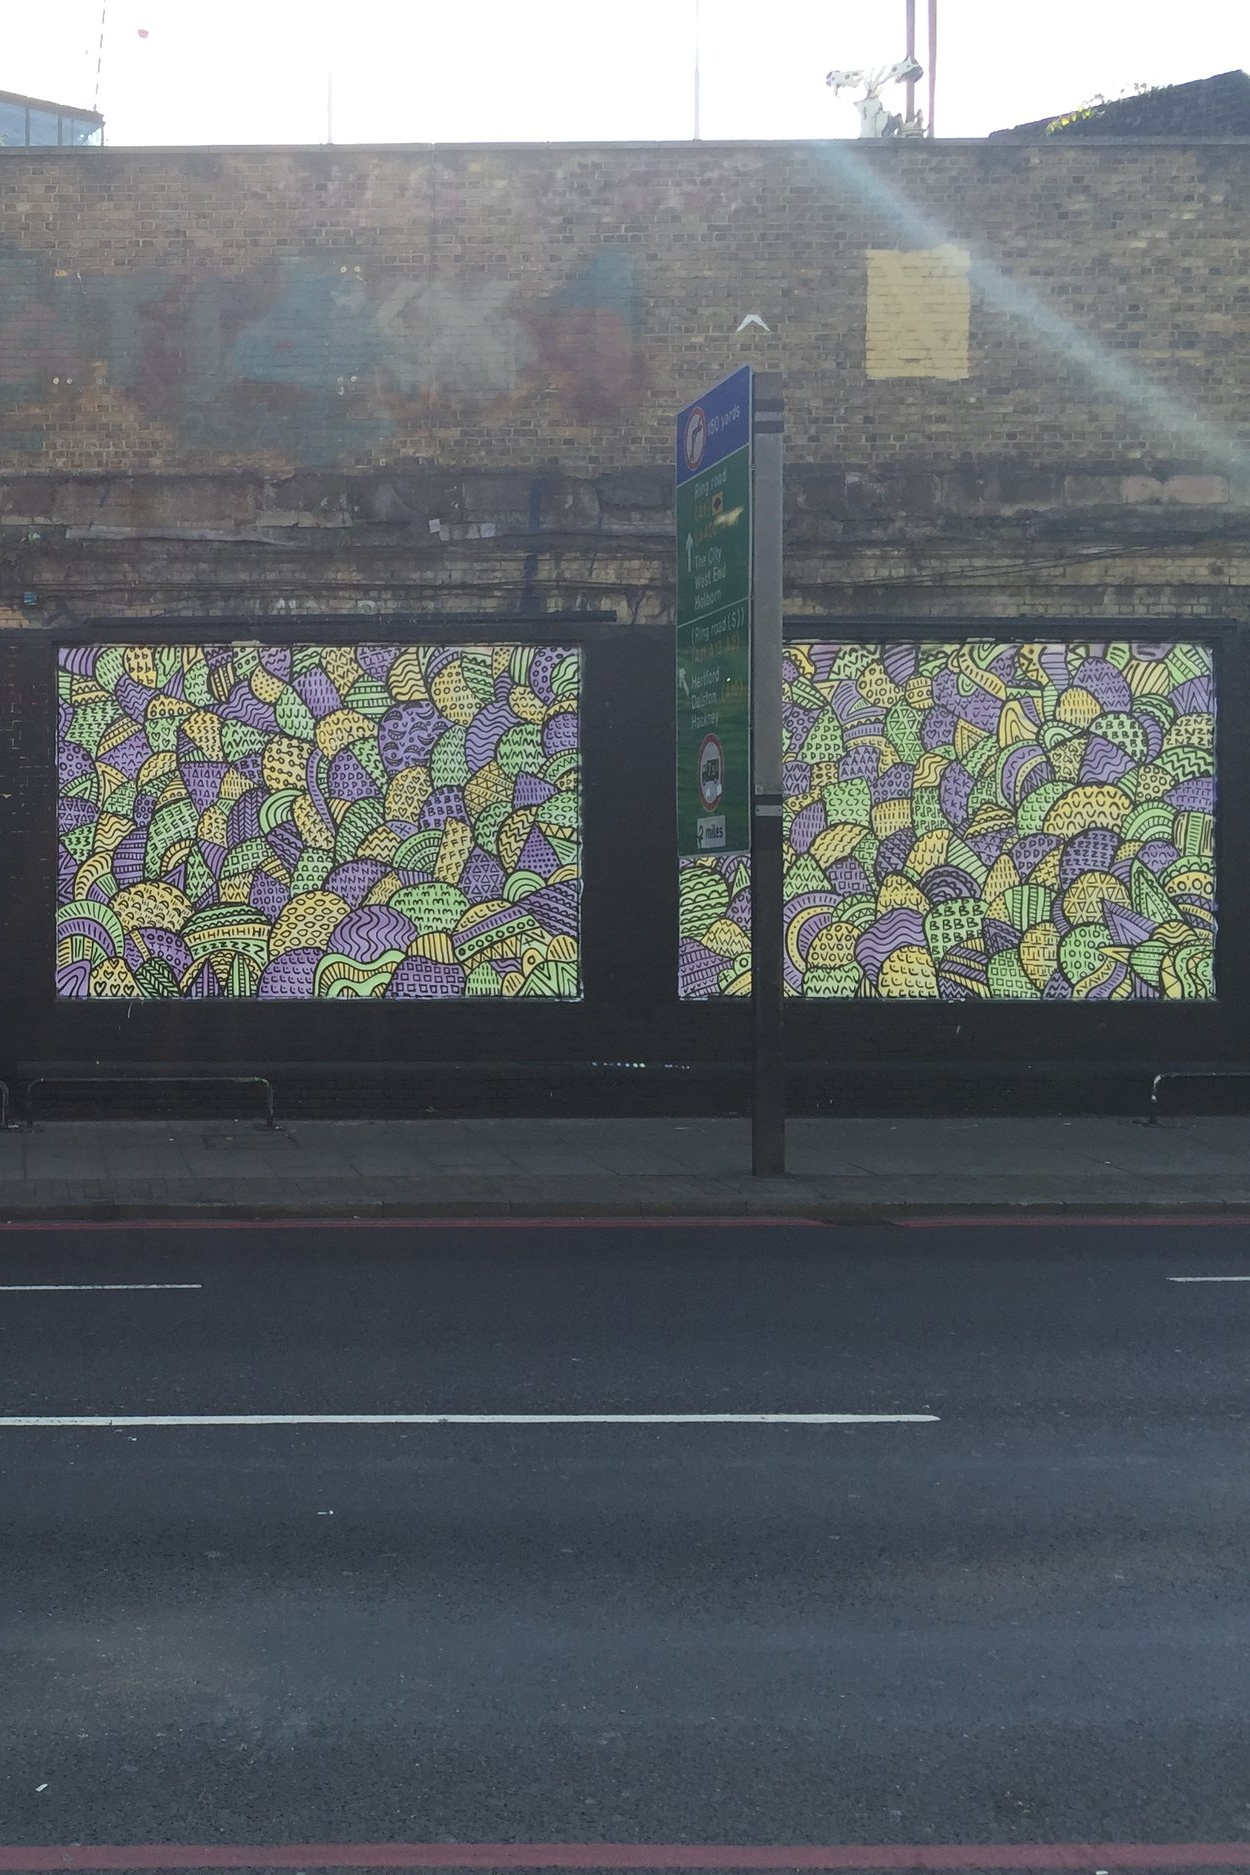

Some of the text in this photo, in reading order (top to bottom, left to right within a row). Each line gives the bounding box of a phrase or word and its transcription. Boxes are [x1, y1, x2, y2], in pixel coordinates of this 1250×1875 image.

[707, 403, 740, 437] 150 yards
[710, 466, 727, 489] road
[694, 546, 722, 570] The City
[694, 561, 727, 590] West End
[694, 588, 722, 611] Holborn
[691, 665, 720, 690] Hertford
[691, 691, 717, 710] Dalston
[691, 711, 719, 730] Hackney
[705, 823, 724, 841] miles
